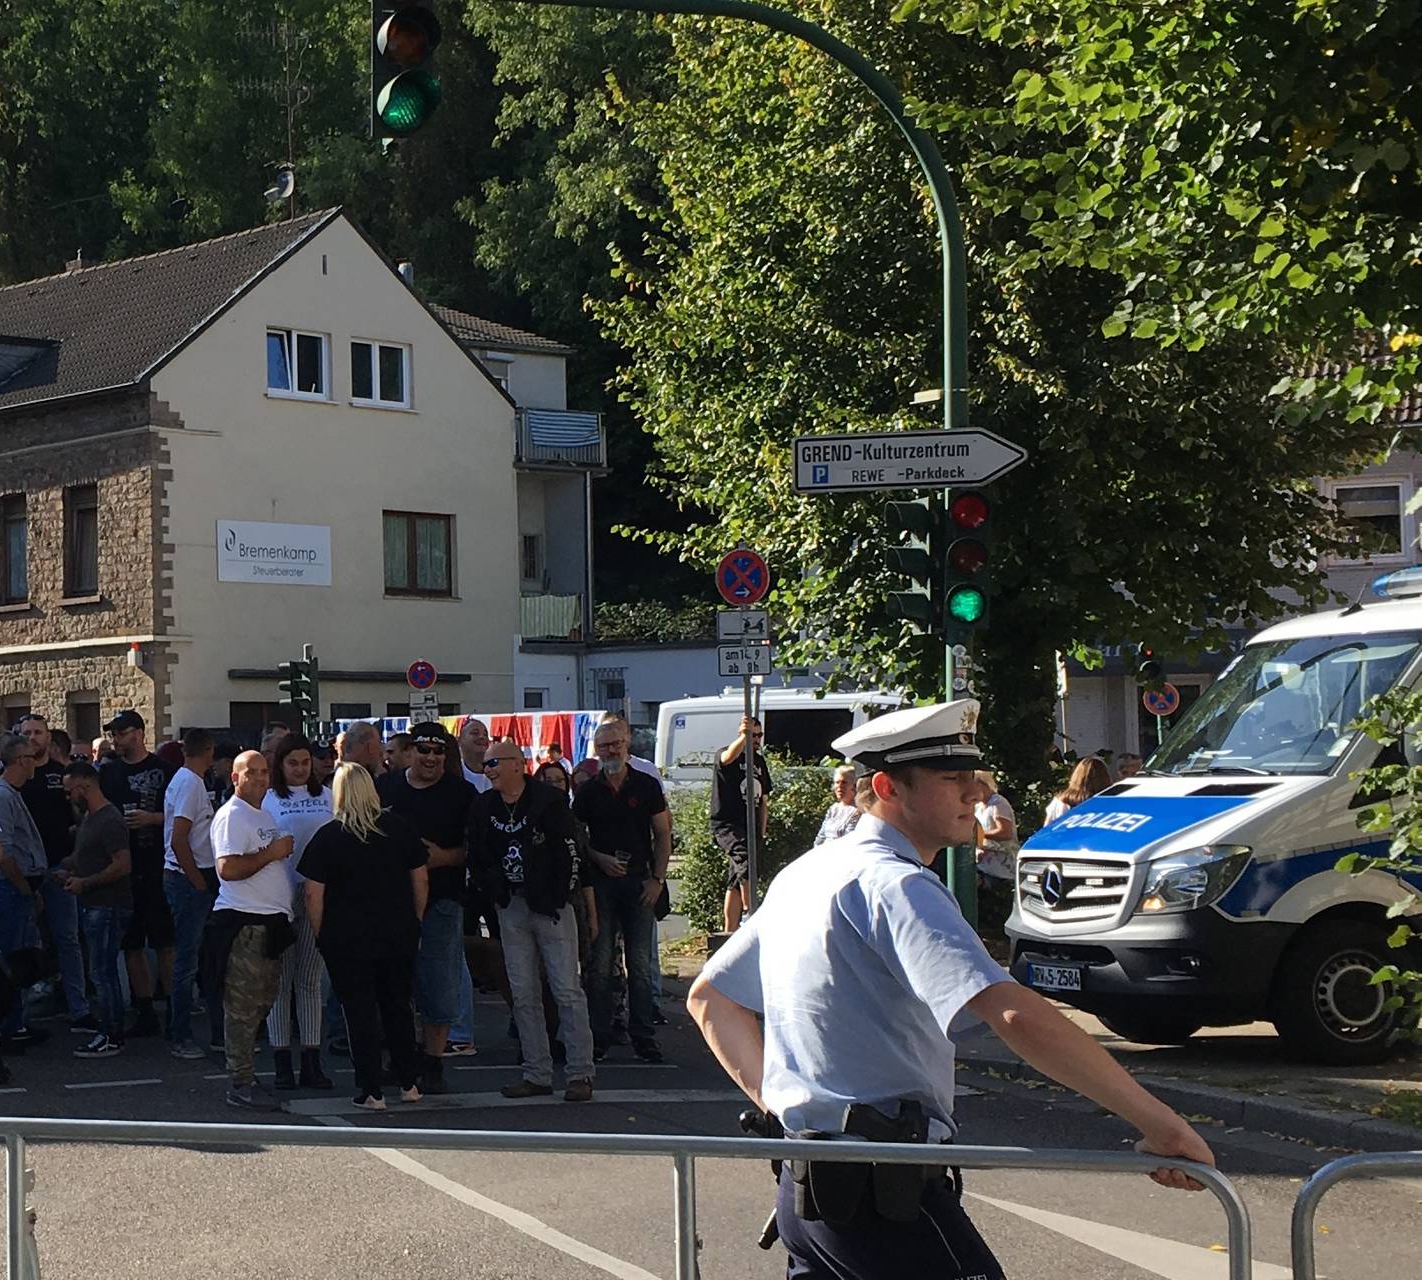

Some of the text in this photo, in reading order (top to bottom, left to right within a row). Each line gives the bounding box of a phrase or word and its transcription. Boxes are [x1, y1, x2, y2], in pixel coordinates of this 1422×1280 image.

[851, 469, 885, 483] REWE
[238, 543, 318, 564] Bremenkamp
[1051, 811, 1154, 833] POLIZEI
